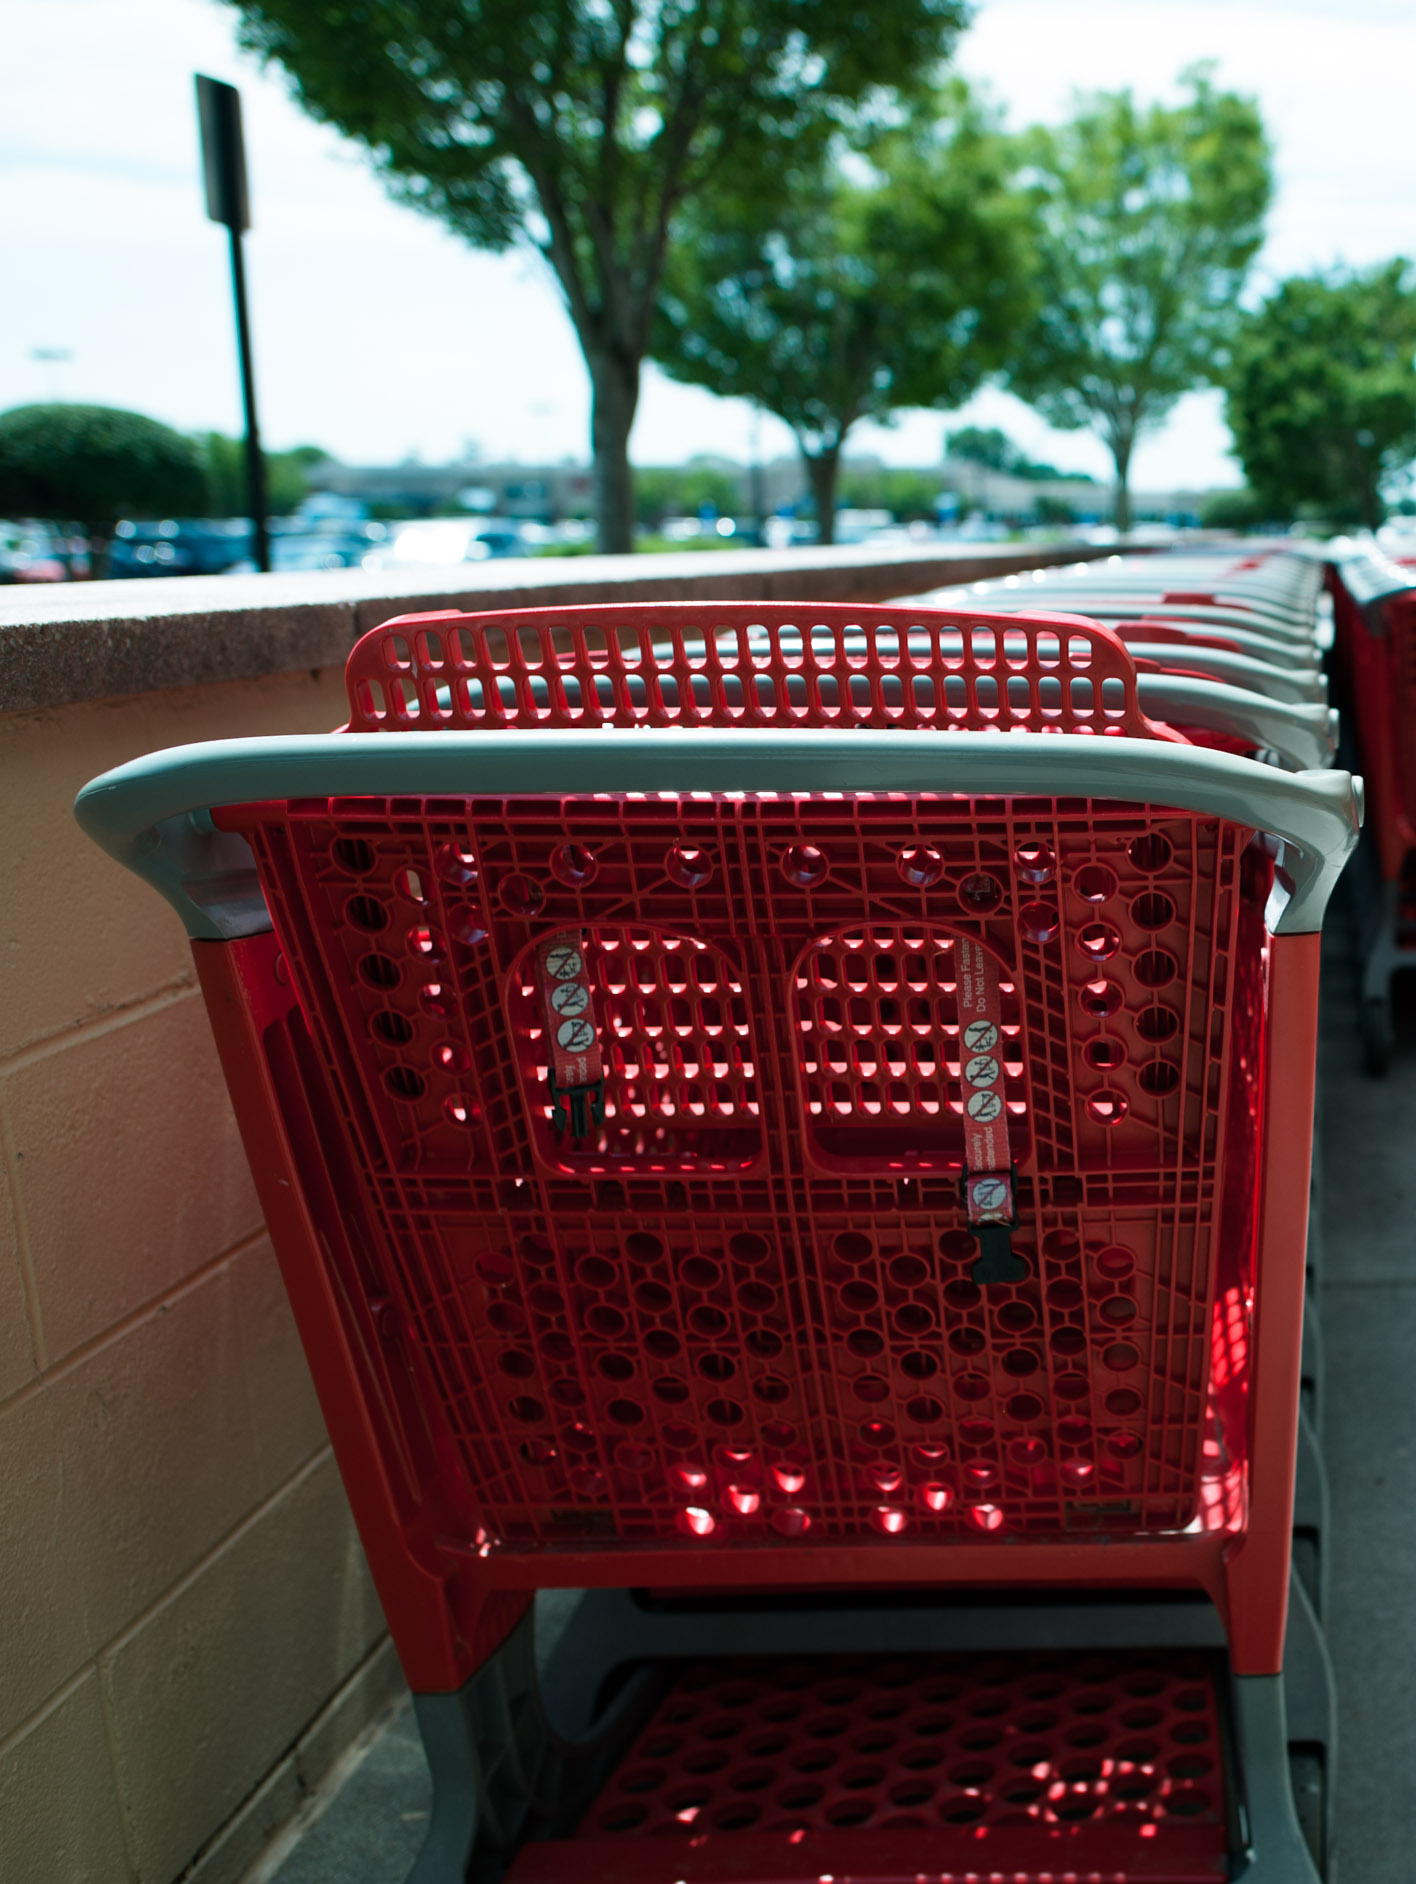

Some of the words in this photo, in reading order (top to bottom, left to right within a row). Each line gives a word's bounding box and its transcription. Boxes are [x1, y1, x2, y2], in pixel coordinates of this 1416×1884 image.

[961, 938, 970, 972] Fasten
[975, 945, 984, 975] Leave
[963, 974, 973, 1008] Please
[976, 977, 985, 996] Not
[977, 997, 986, 1012] Do
[972, 1133, 983, 1171] Securely
